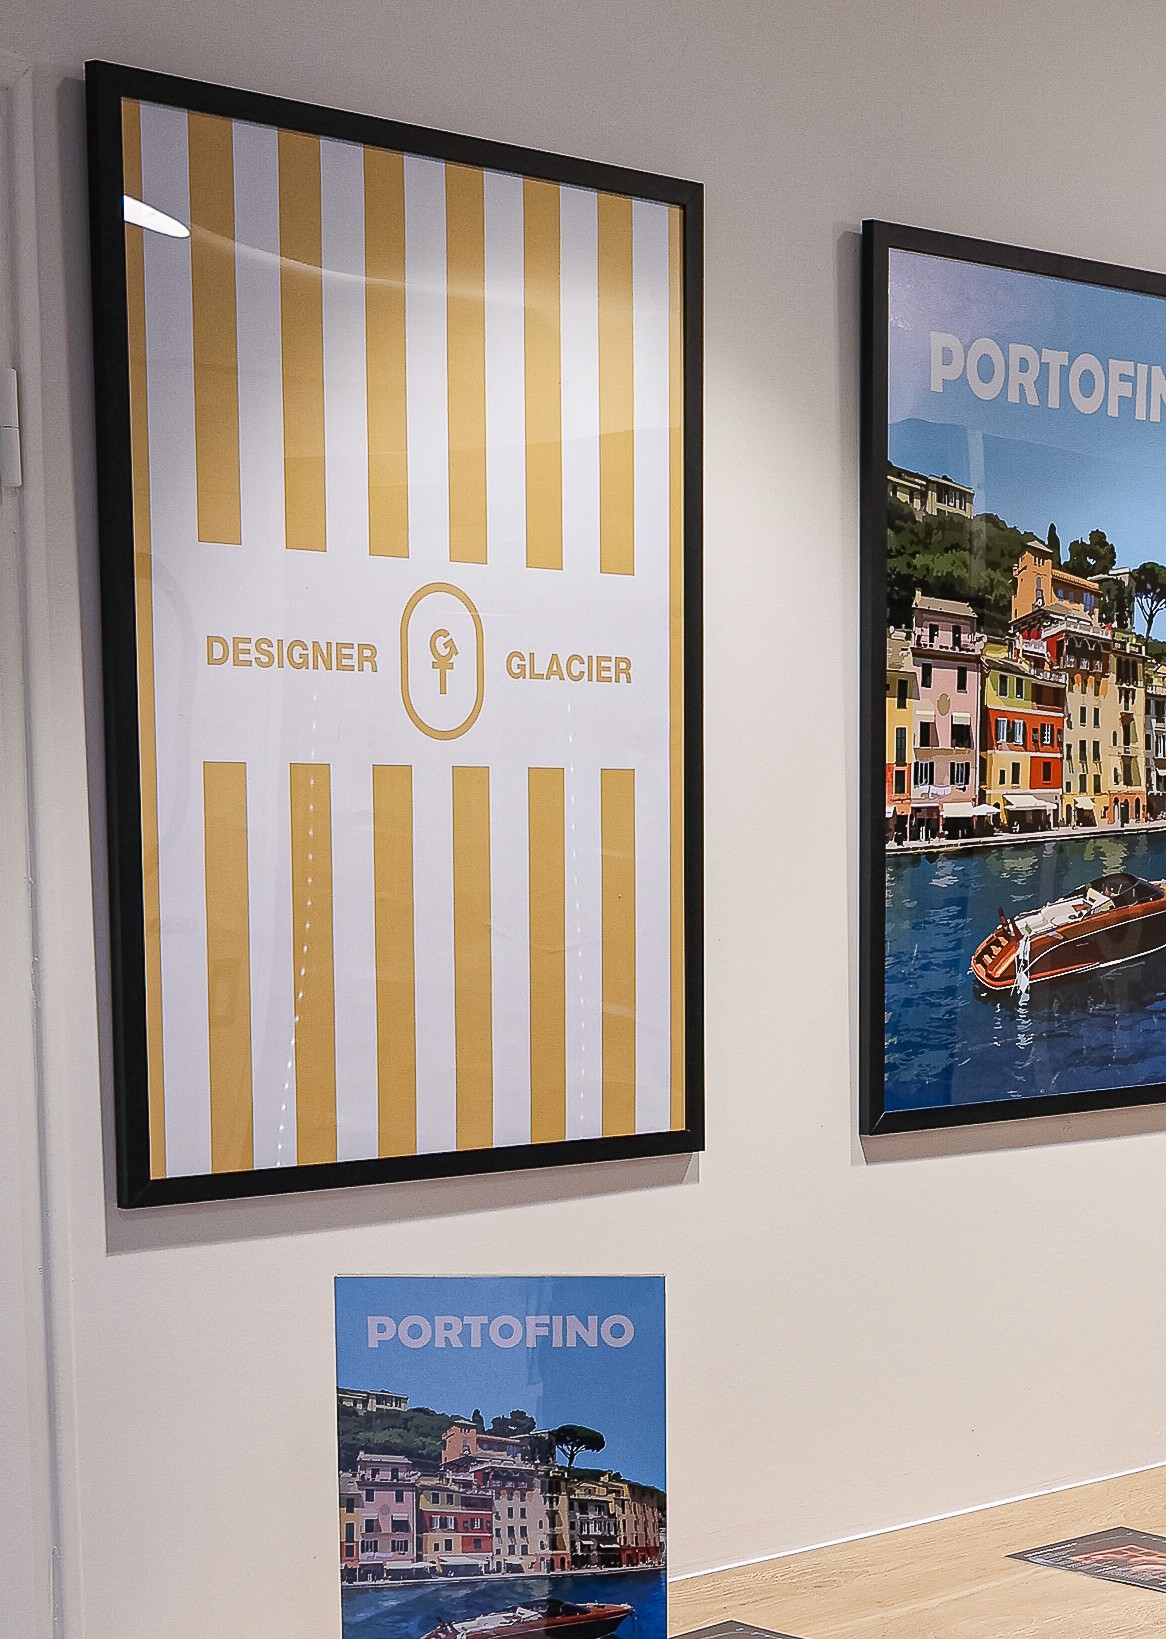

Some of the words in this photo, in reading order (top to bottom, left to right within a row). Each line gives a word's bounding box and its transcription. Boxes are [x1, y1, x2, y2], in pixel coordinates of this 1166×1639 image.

[206, 635, 379, 673] DESIGNER
[505, 650, 633, 684] GLACIER
[366, 1314, 635, 1349] PORTOFINO
